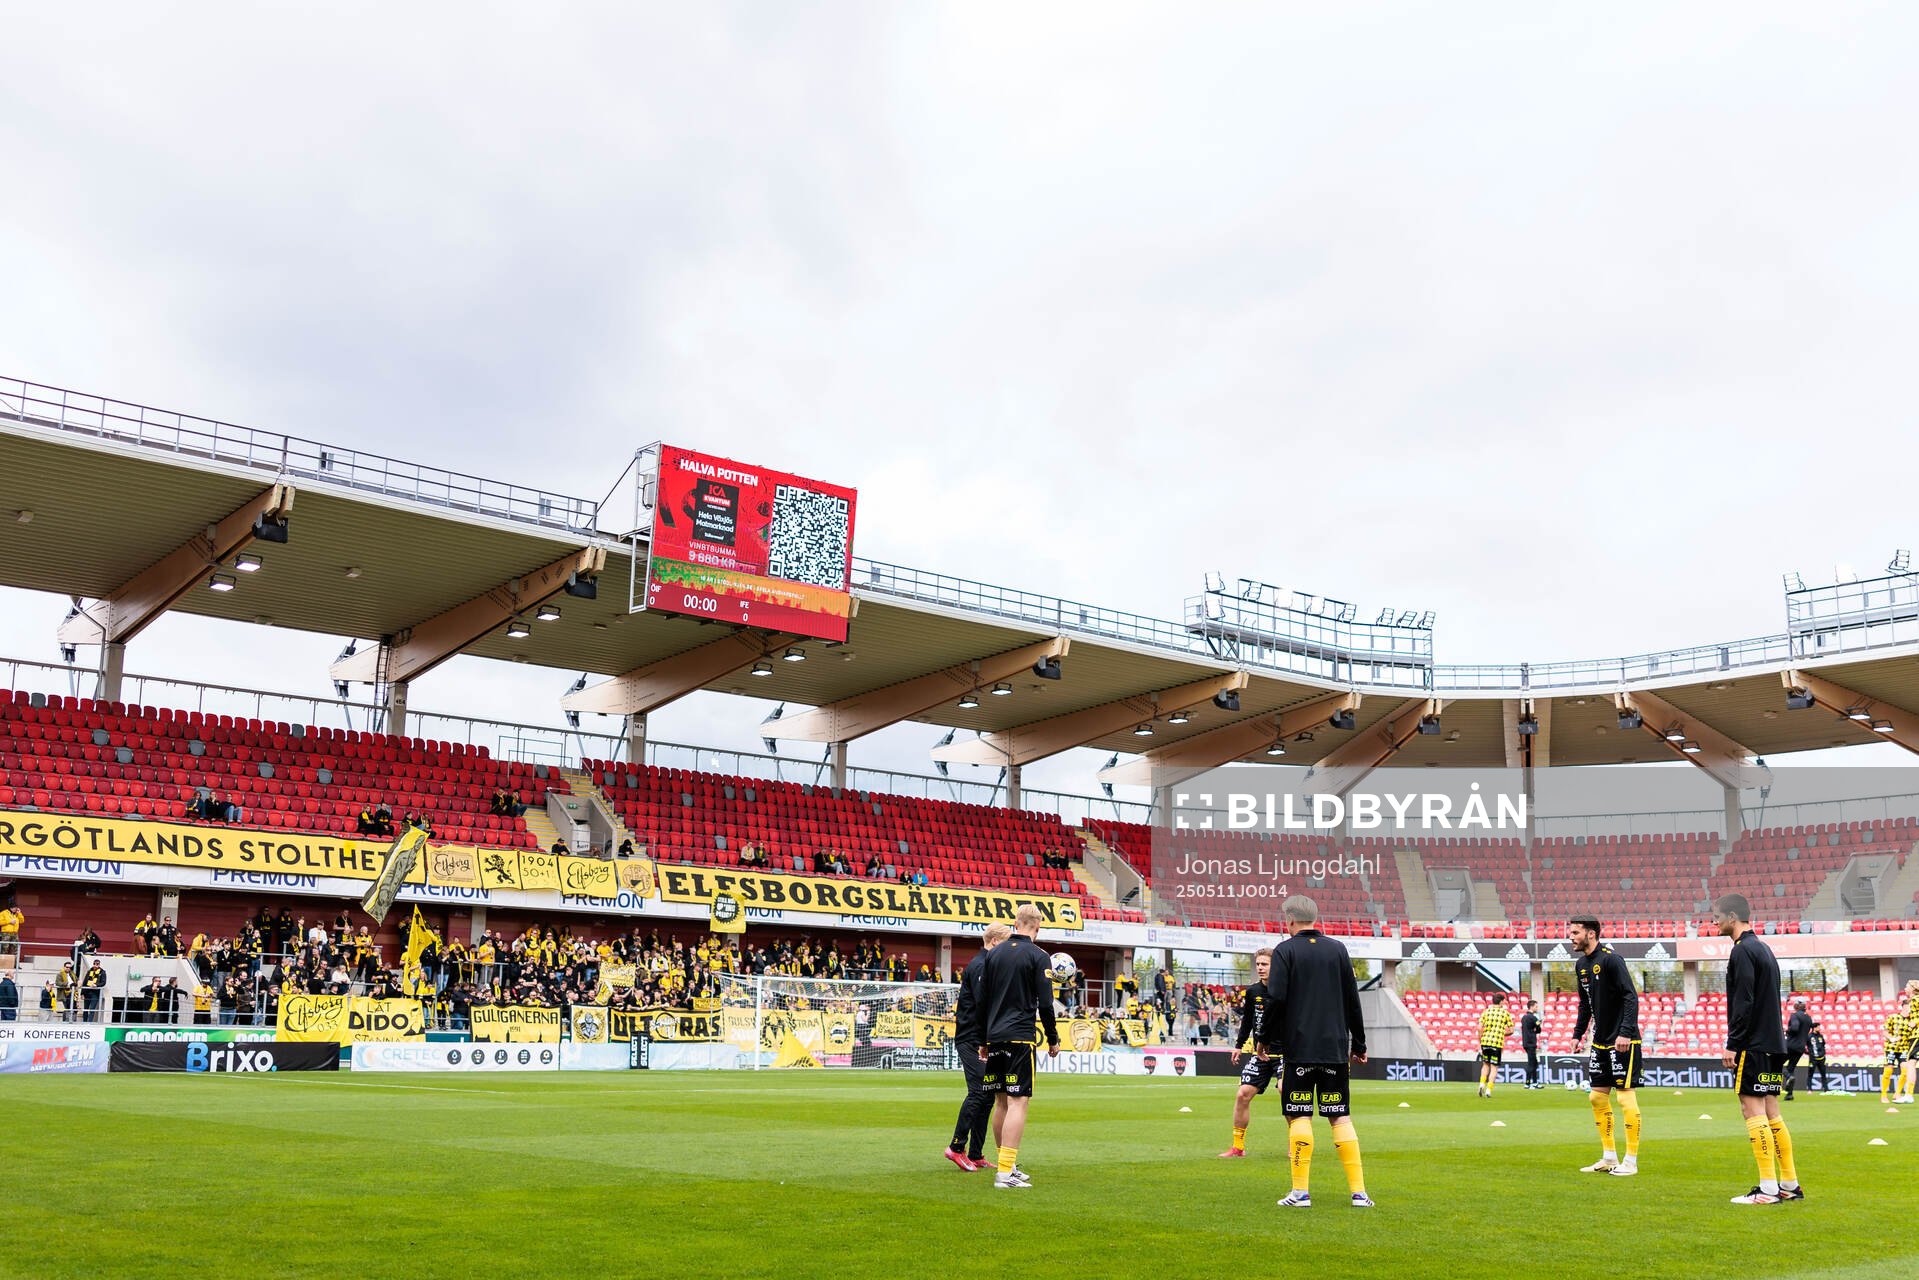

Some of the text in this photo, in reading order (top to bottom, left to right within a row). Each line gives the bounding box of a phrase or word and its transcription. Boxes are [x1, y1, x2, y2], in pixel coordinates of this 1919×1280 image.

[680, 459, 758, 487] HALVA POTTEN
[708, 484, 726, 498] ICA
[704, 495, 731, 507] KVANTUM
[698, 511, 713, 521] Hela
[689, 542, 737, 557] VINSTSUMMA
[721, 557, 736, 569] KR
[650, 583, 661, 593] ÖIF
[649, 596, 655, 605] 0
[683, 594, 717, 612] 00:00
[739, 600, 749, 609] IFE
[742, 612, 748, 622] 0
[522, 855, 554, 868] 1904
[348, 1011, 409, 1031] DIDO
[473, 1009, 559, 1025] GULIGANERNA
[24, 1030, 91, 1040] KONFERENS
[1386, 1061, 1445, 1081] stadium
[1644, 1066, 1735, 1088] stadium
[1292, 1092, 1311, 1101] EAB
[1321, 1094, 1339, 1103] EAB
